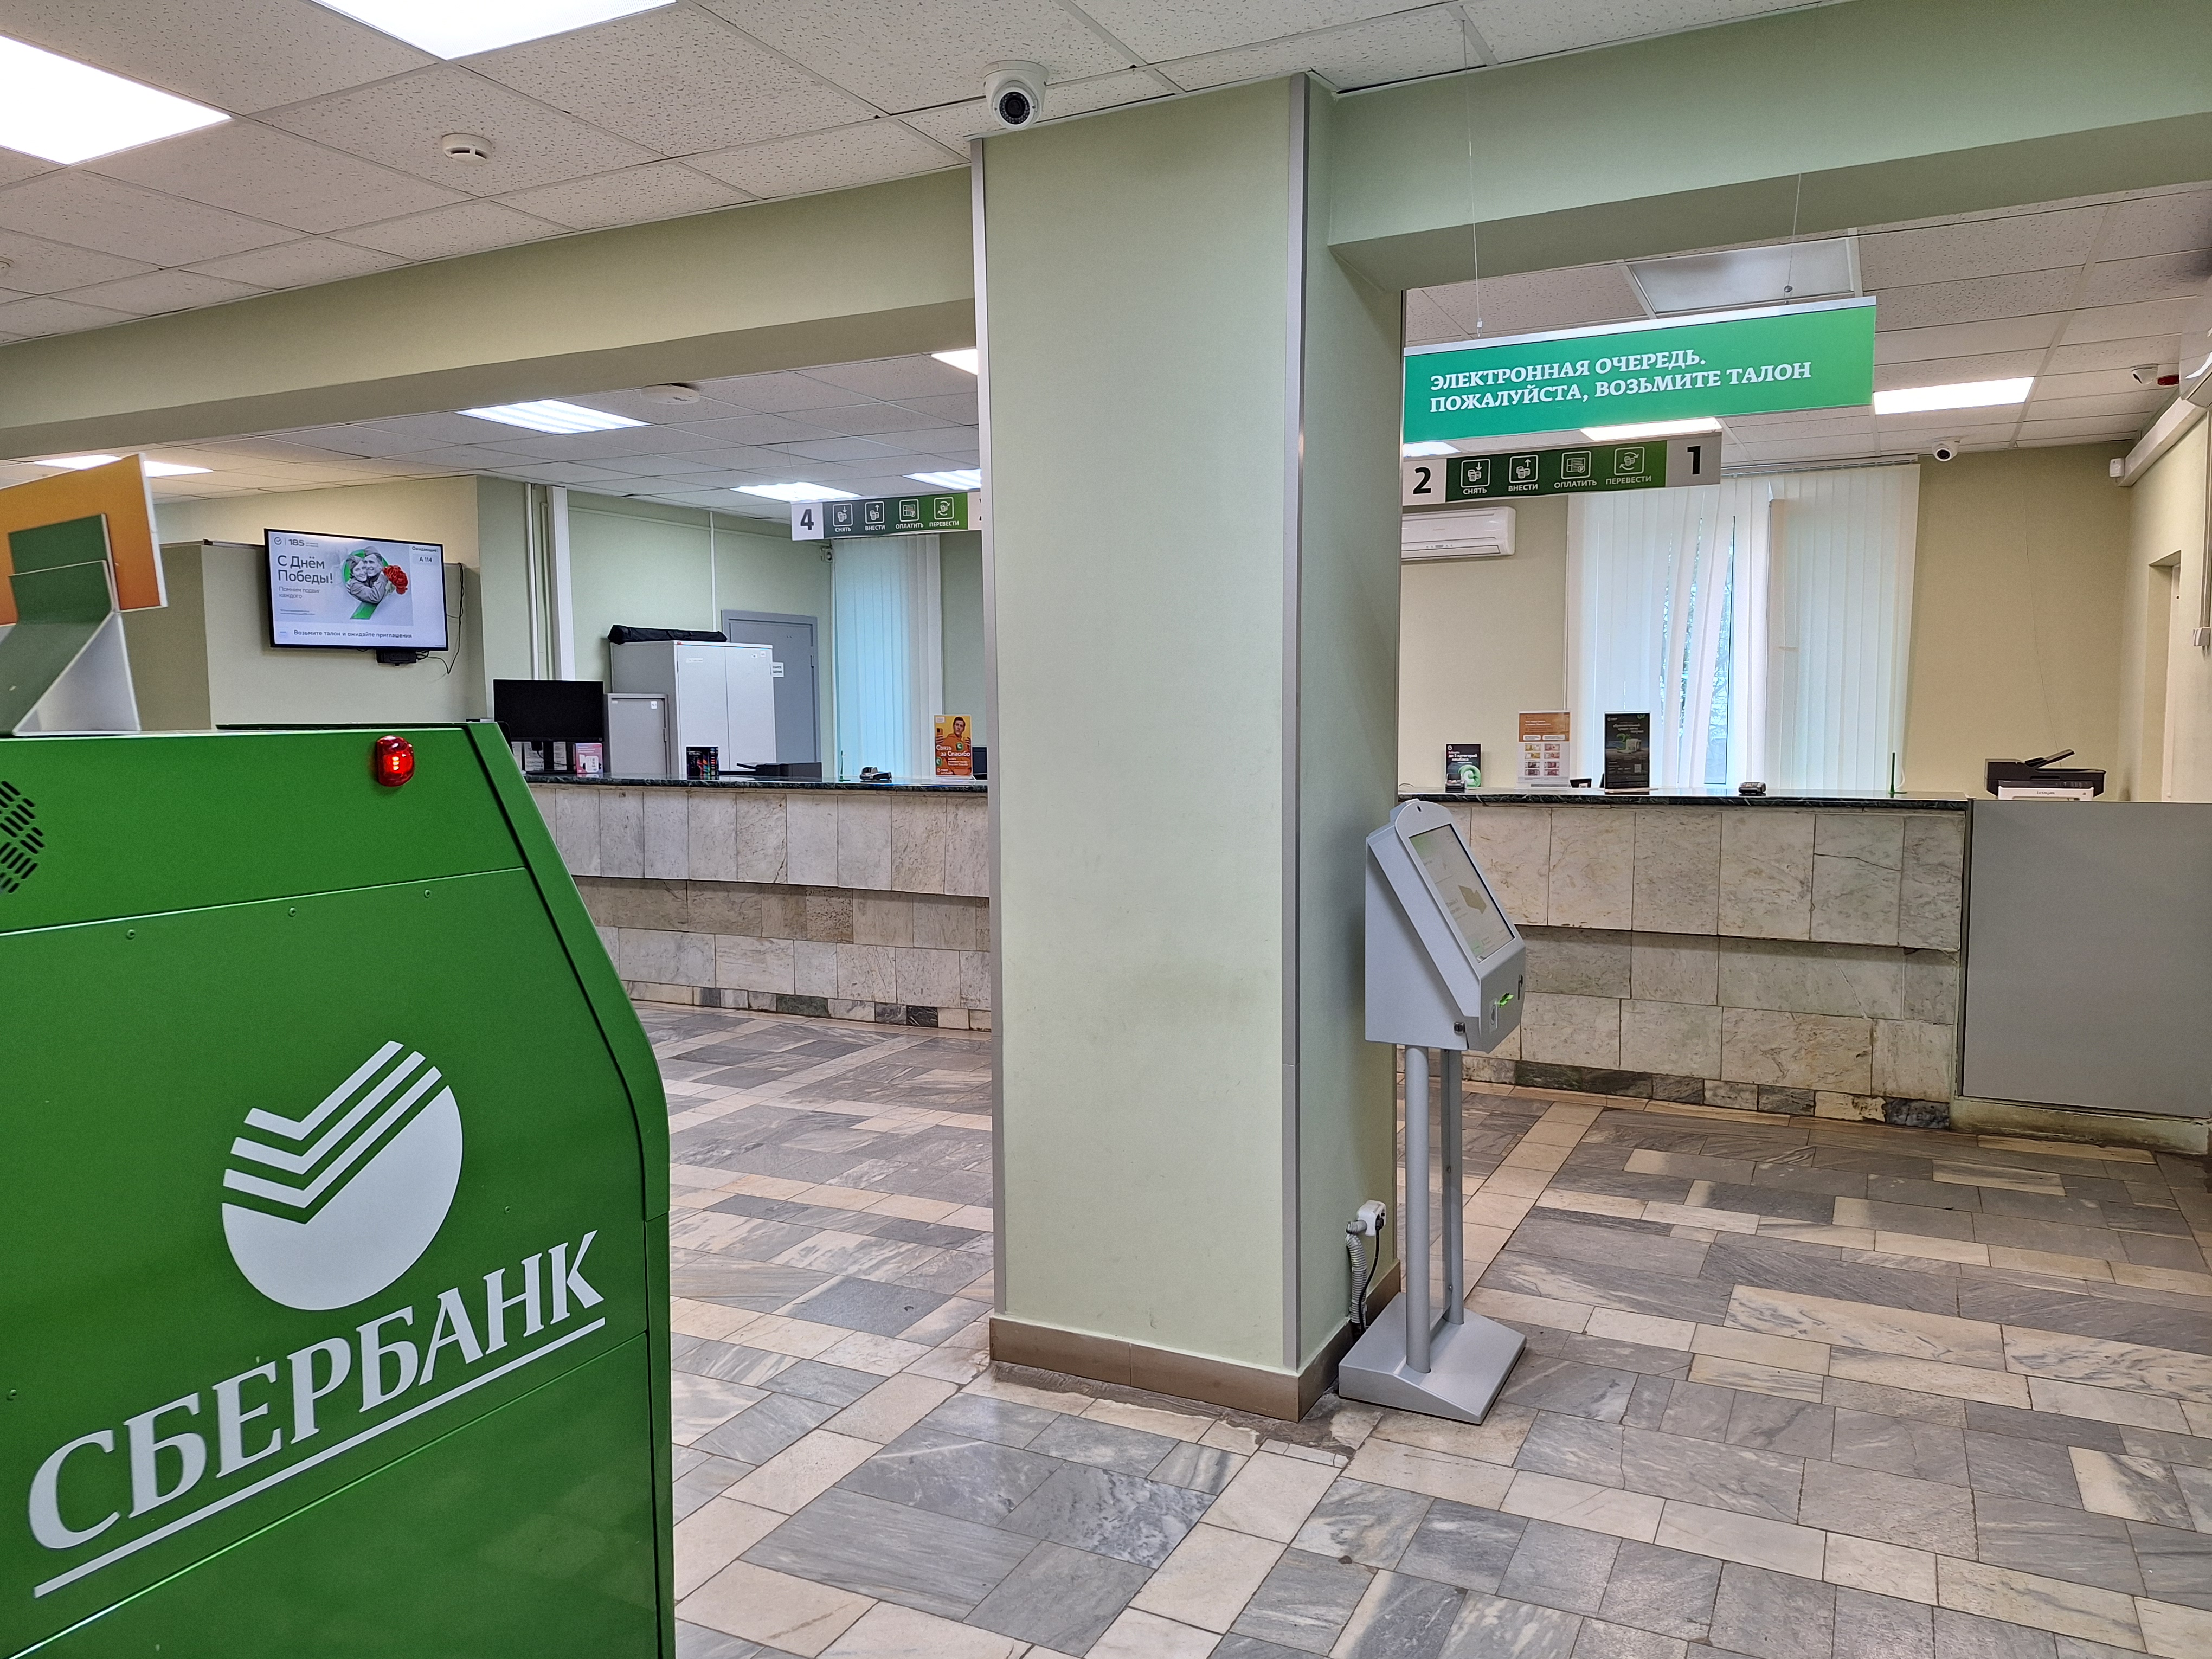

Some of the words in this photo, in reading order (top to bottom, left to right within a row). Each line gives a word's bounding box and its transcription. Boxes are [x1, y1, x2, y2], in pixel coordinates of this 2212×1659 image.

[1430, 359, 1590, 390] ЭЛЕКТРОННАЯ
[1595, 349, 1706, 374] ОЧЕРЕДЬ.
[1430, 385, 1589, 413] ПОЖАЛУЙСТА,
[1594, 370, 1721, 397] ВОЗЬМИТЕ
[1726, 362, 1812, 385] ТАЛОН
[1687, 445, 1701, 475] 1
[1412, 467, 1432, 494] 2
[1508, 484, 1538, 492] ВНЕСТИ
[1554, 479, 1597, 488] ОПЛАТИТЬ
[1605, 475, 1651, 485] ПЕРЕВЕСТИ
[800, 509, 814, 531] 4
[278, 555, 287, 567] С
[290, 556, 325, 569] Днём
[278, 570, 333, 585] Победы!
[28, 1229, 605, 1549] СБЕРБАНК
